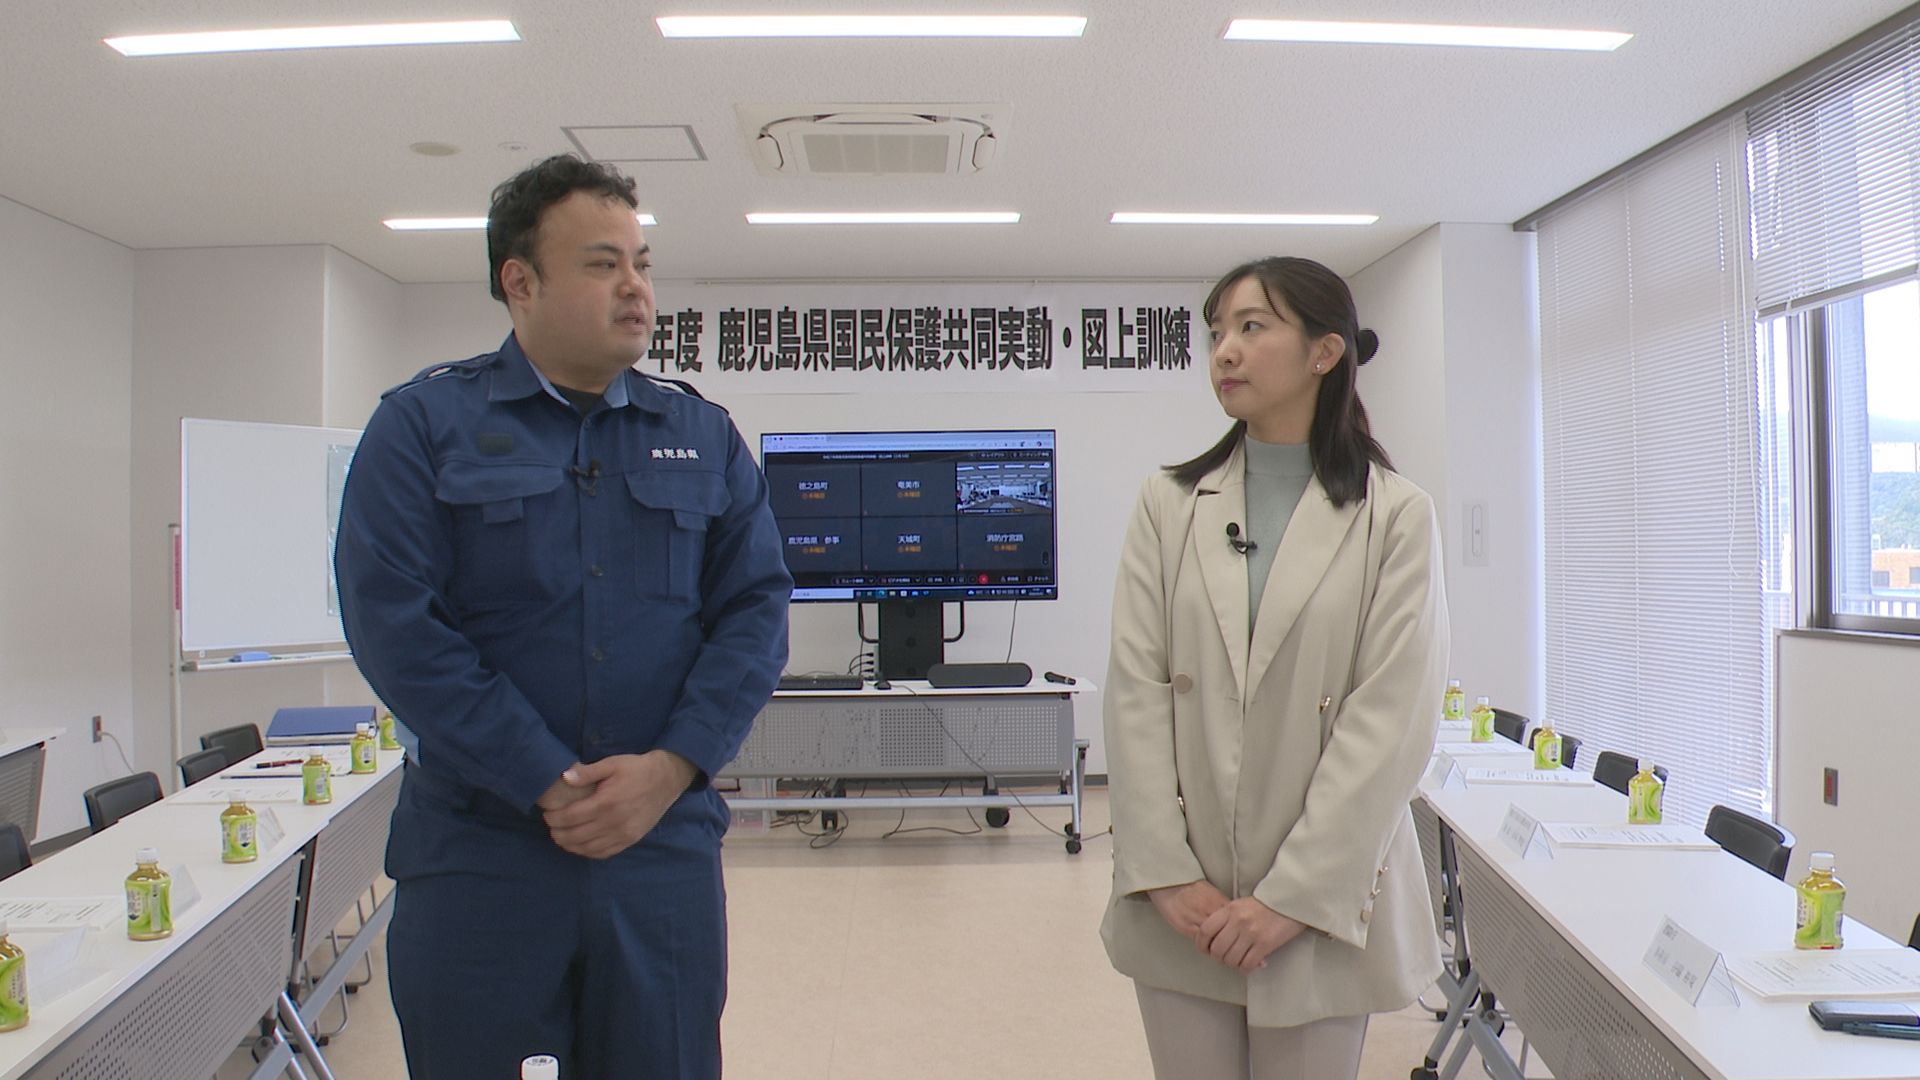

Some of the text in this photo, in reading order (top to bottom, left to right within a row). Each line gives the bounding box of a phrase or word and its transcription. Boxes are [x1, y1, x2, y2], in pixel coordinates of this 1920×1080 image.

[648, 306, 1191, 372] 年度 鹿児島県国民保護共同実動・図上訓練
[651, 448, 699, 459] 鹿児島県
